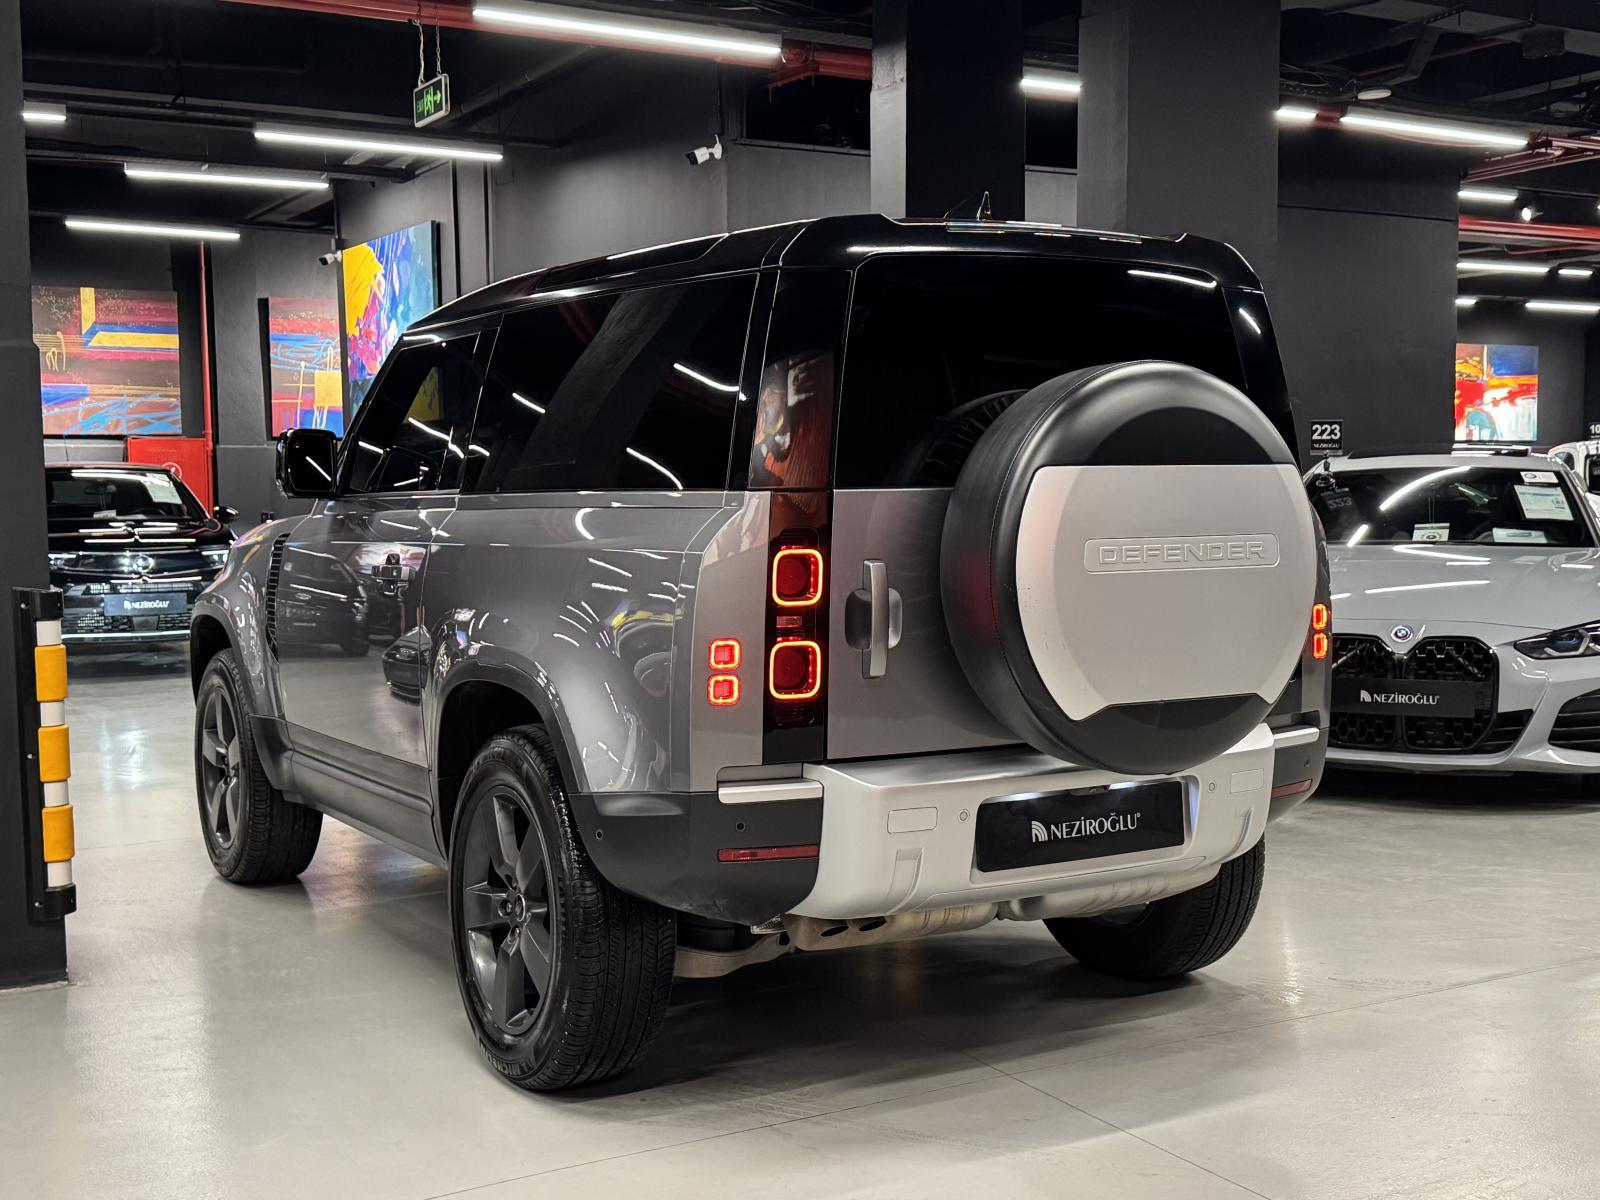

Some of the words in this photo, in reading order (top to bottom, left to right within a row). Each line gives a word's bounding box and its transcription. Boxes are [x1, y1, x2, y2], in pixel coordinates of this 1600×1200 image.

[1311, 424, 1341, 440] 223
[1099, 541, 1265, 564] DEFENDER
[1373, 692, 1438, 704] NEZİROĞLU
